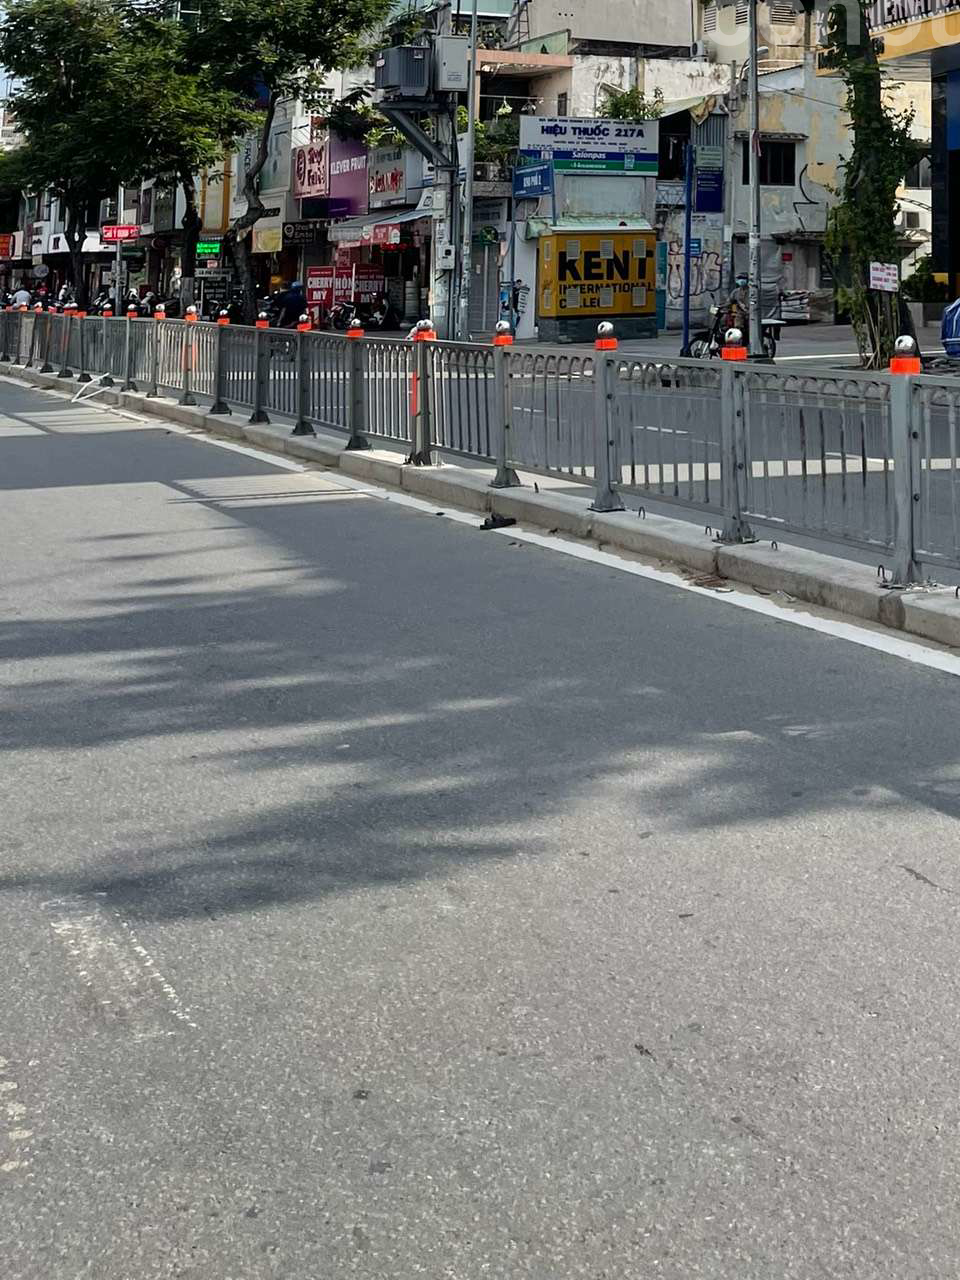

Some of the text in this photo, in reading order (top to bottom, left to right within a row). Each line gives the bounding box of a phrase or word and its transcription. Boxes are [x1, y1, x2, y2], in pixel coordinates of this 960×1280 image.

[541, 124, 645, 138] HIỆU THUỐC 217A
[572, 151, 606, 160] Salonpas
[558, 250, 654, 281] KENT
